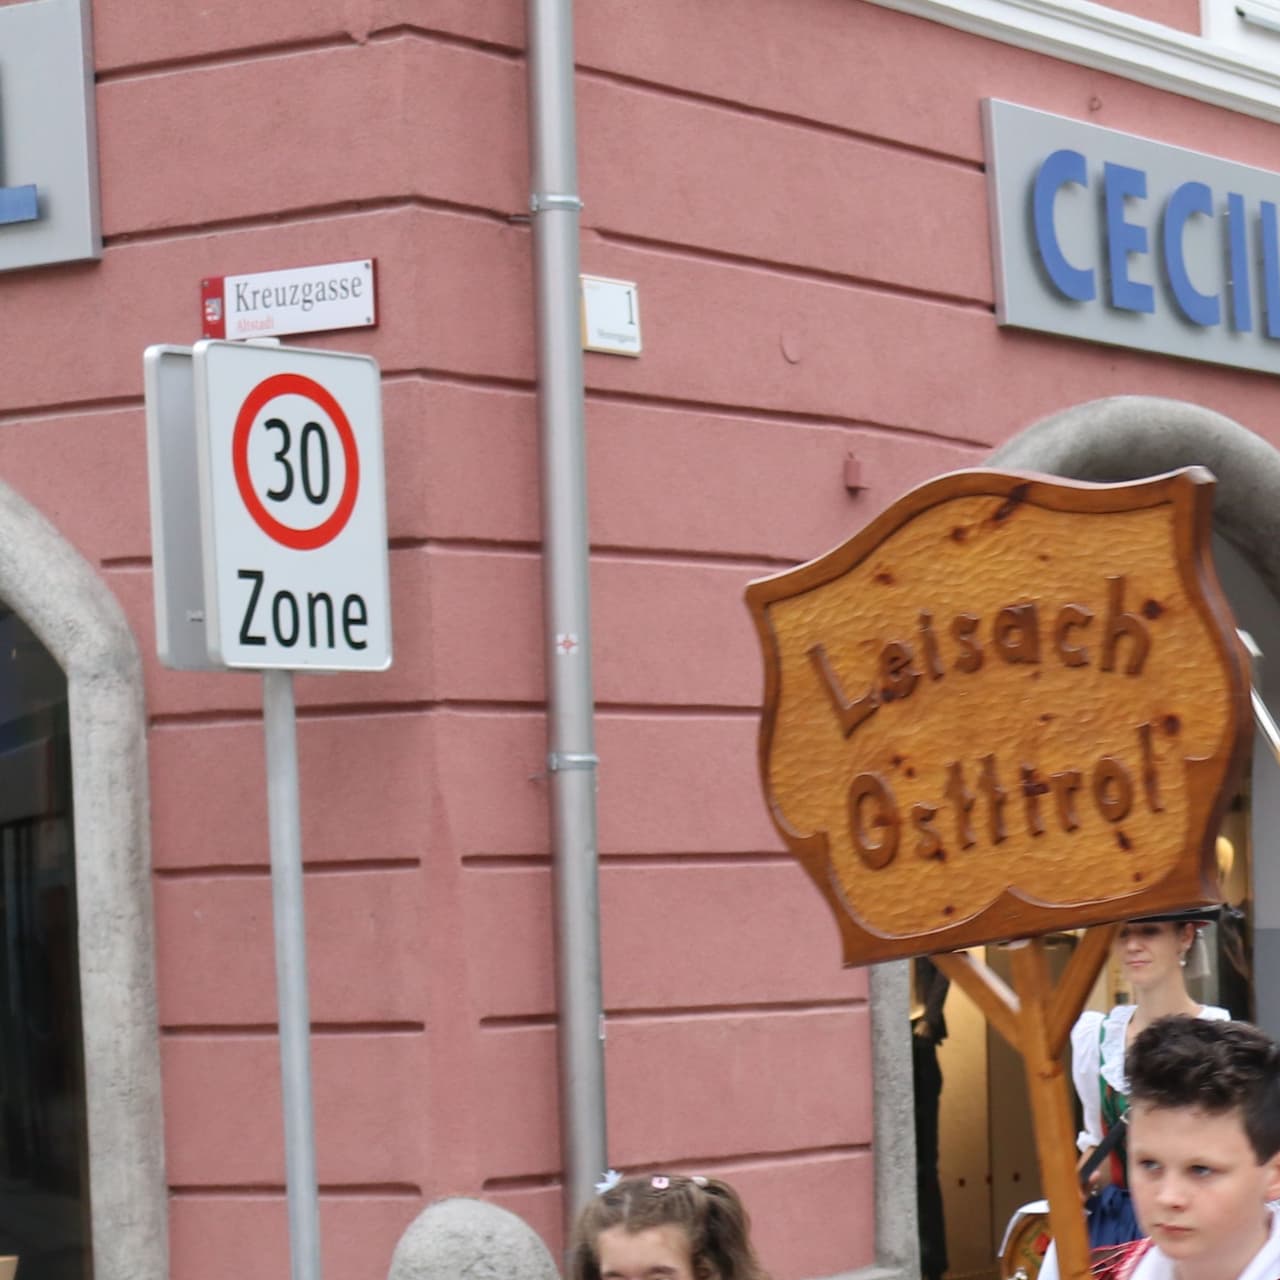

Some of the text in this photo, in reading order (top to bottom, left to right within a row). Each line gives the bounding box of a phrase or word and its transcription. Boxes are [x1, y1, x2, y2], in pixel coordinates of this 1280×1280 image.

[235, 275, 363, 313] Kreuzgasse
[263, 417, 330, 505] 30
[237, 568, 368, 651] Zone
[807, 574, 1152, 739] Leisach
[847, 722, 1164, 871] Osttirol
